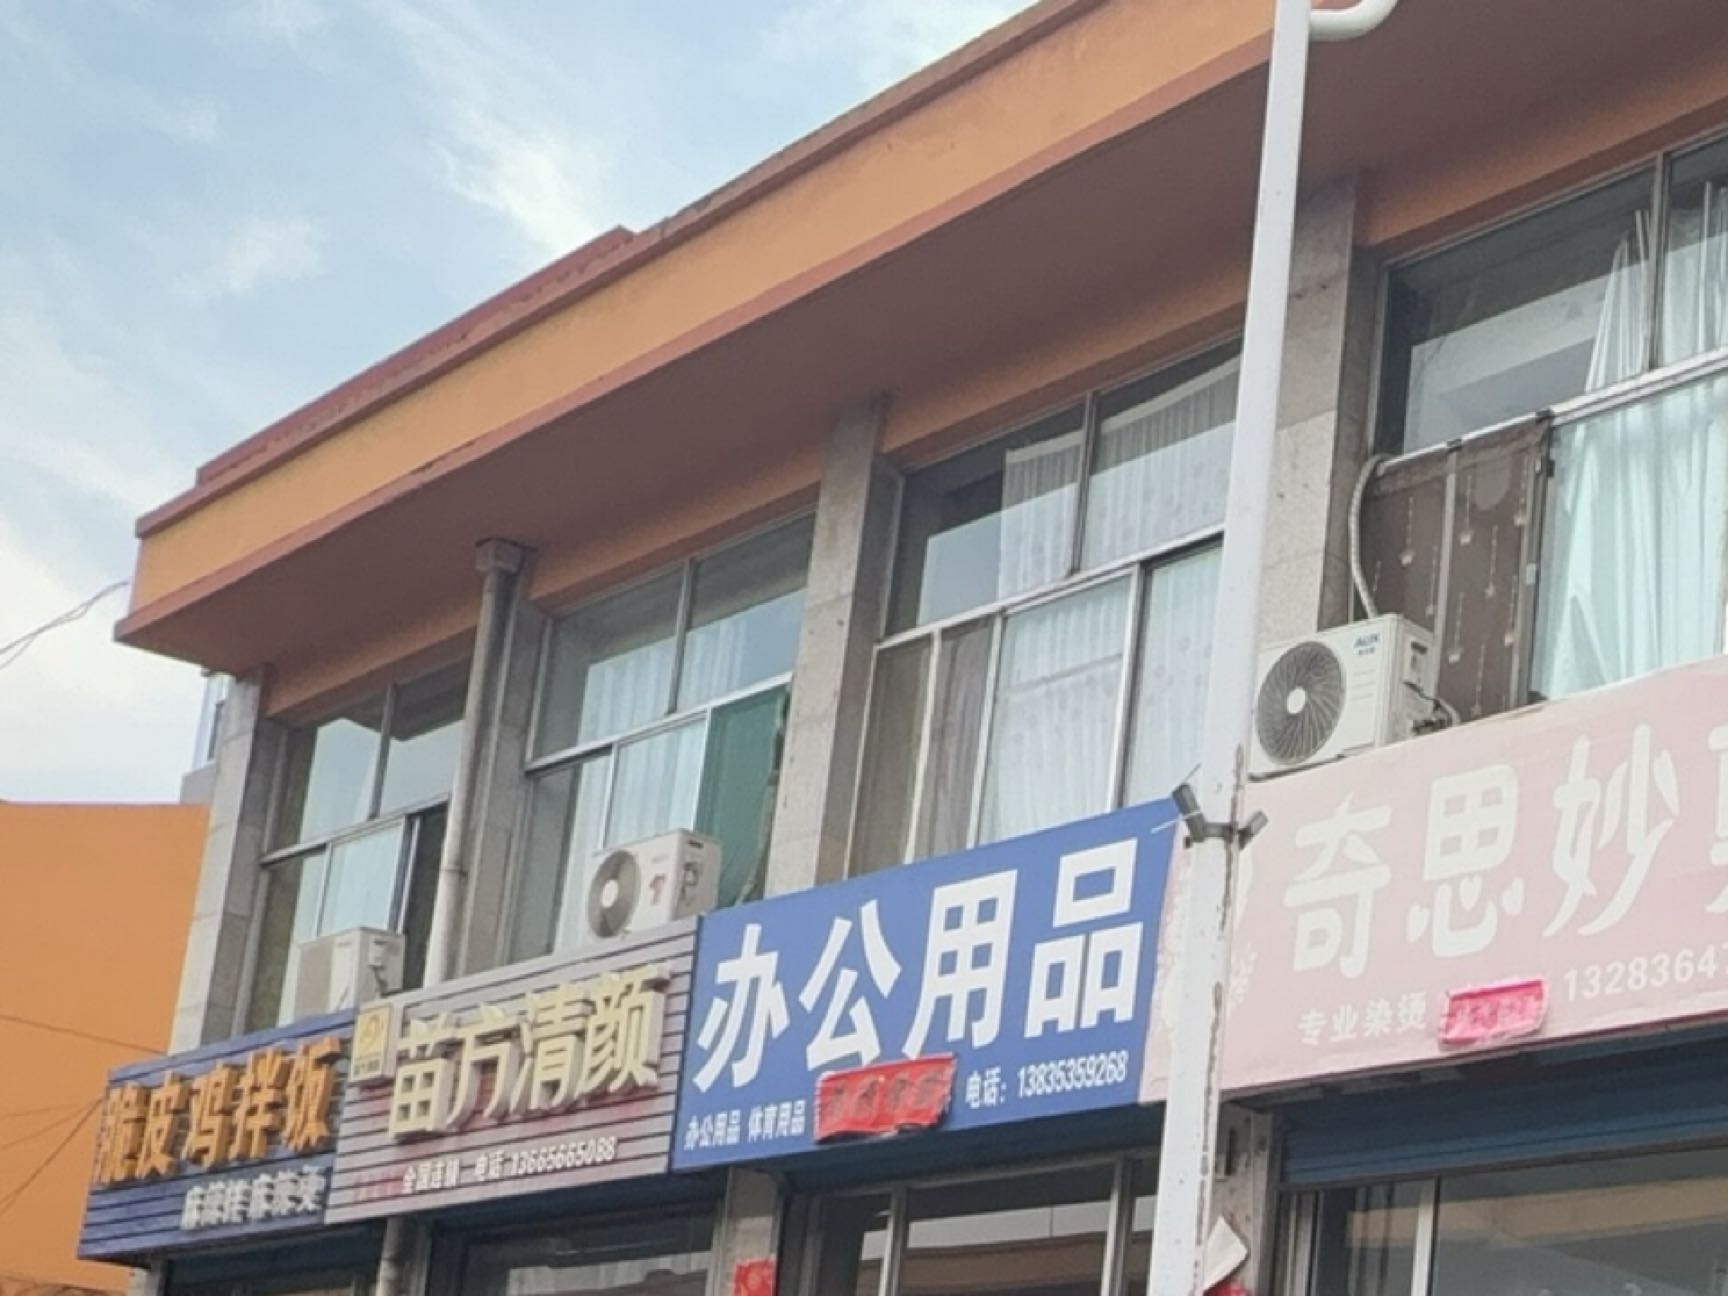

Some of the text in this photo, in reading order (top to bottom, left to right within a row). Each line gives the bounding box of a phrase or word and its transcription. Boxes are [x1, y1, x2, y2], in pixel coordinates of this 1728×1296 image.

[690, 838, 1145, 1093] 办公用品
[1300, 991, 1427, 1046] 专业染烫
[388, 964, 670, 1140] 苗方清颜
[683, 1109, 740, 1151] 办公用品
[748, 1100, 806, 1141] 体育用品
